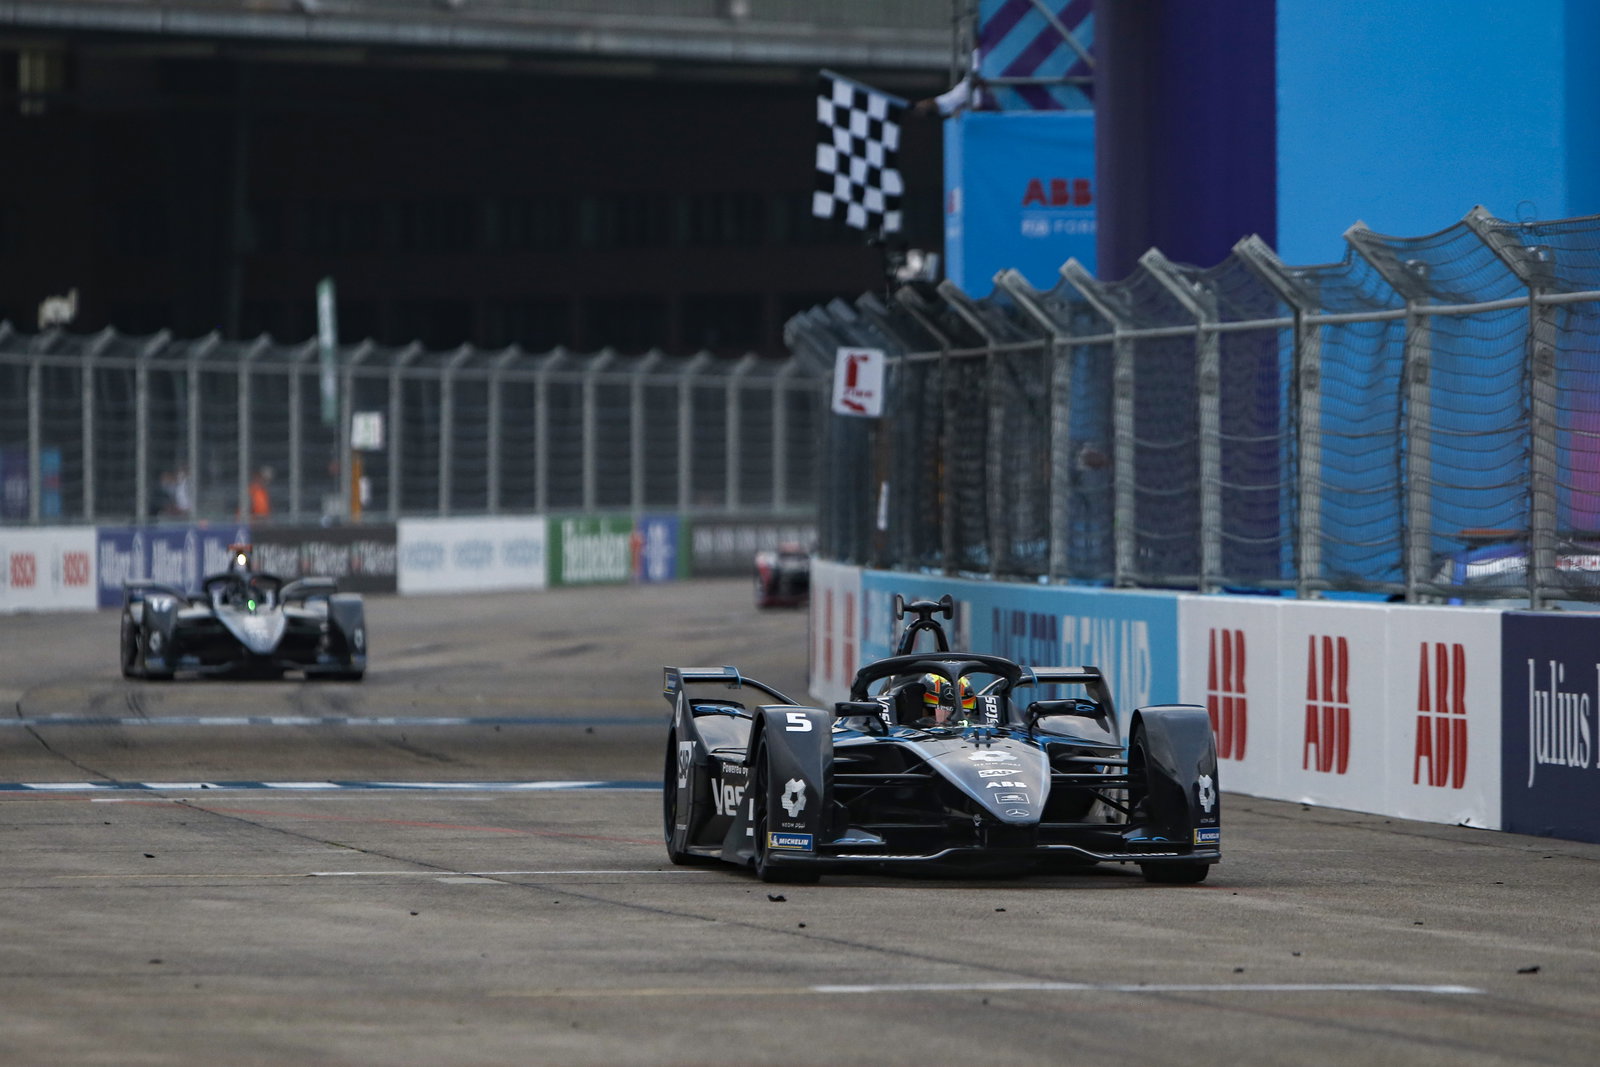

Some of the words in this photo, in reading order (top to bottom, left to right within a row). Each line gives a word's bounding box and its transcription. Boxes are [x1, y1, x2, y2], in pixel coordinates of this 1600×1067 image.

[1022, 178, 1092, 207] ABB
[785, 712, 813, 732] 5
[1207, 628, 1247, 761] ABB
[1302, 635, 1351, 775] ABB
[1412, 642, 1468, 789] ABB
[1527, 658, 1591, 788] Julius
[722, 762, 741, 774] Powered
[779, 837, 809, 846] MICHELIN
